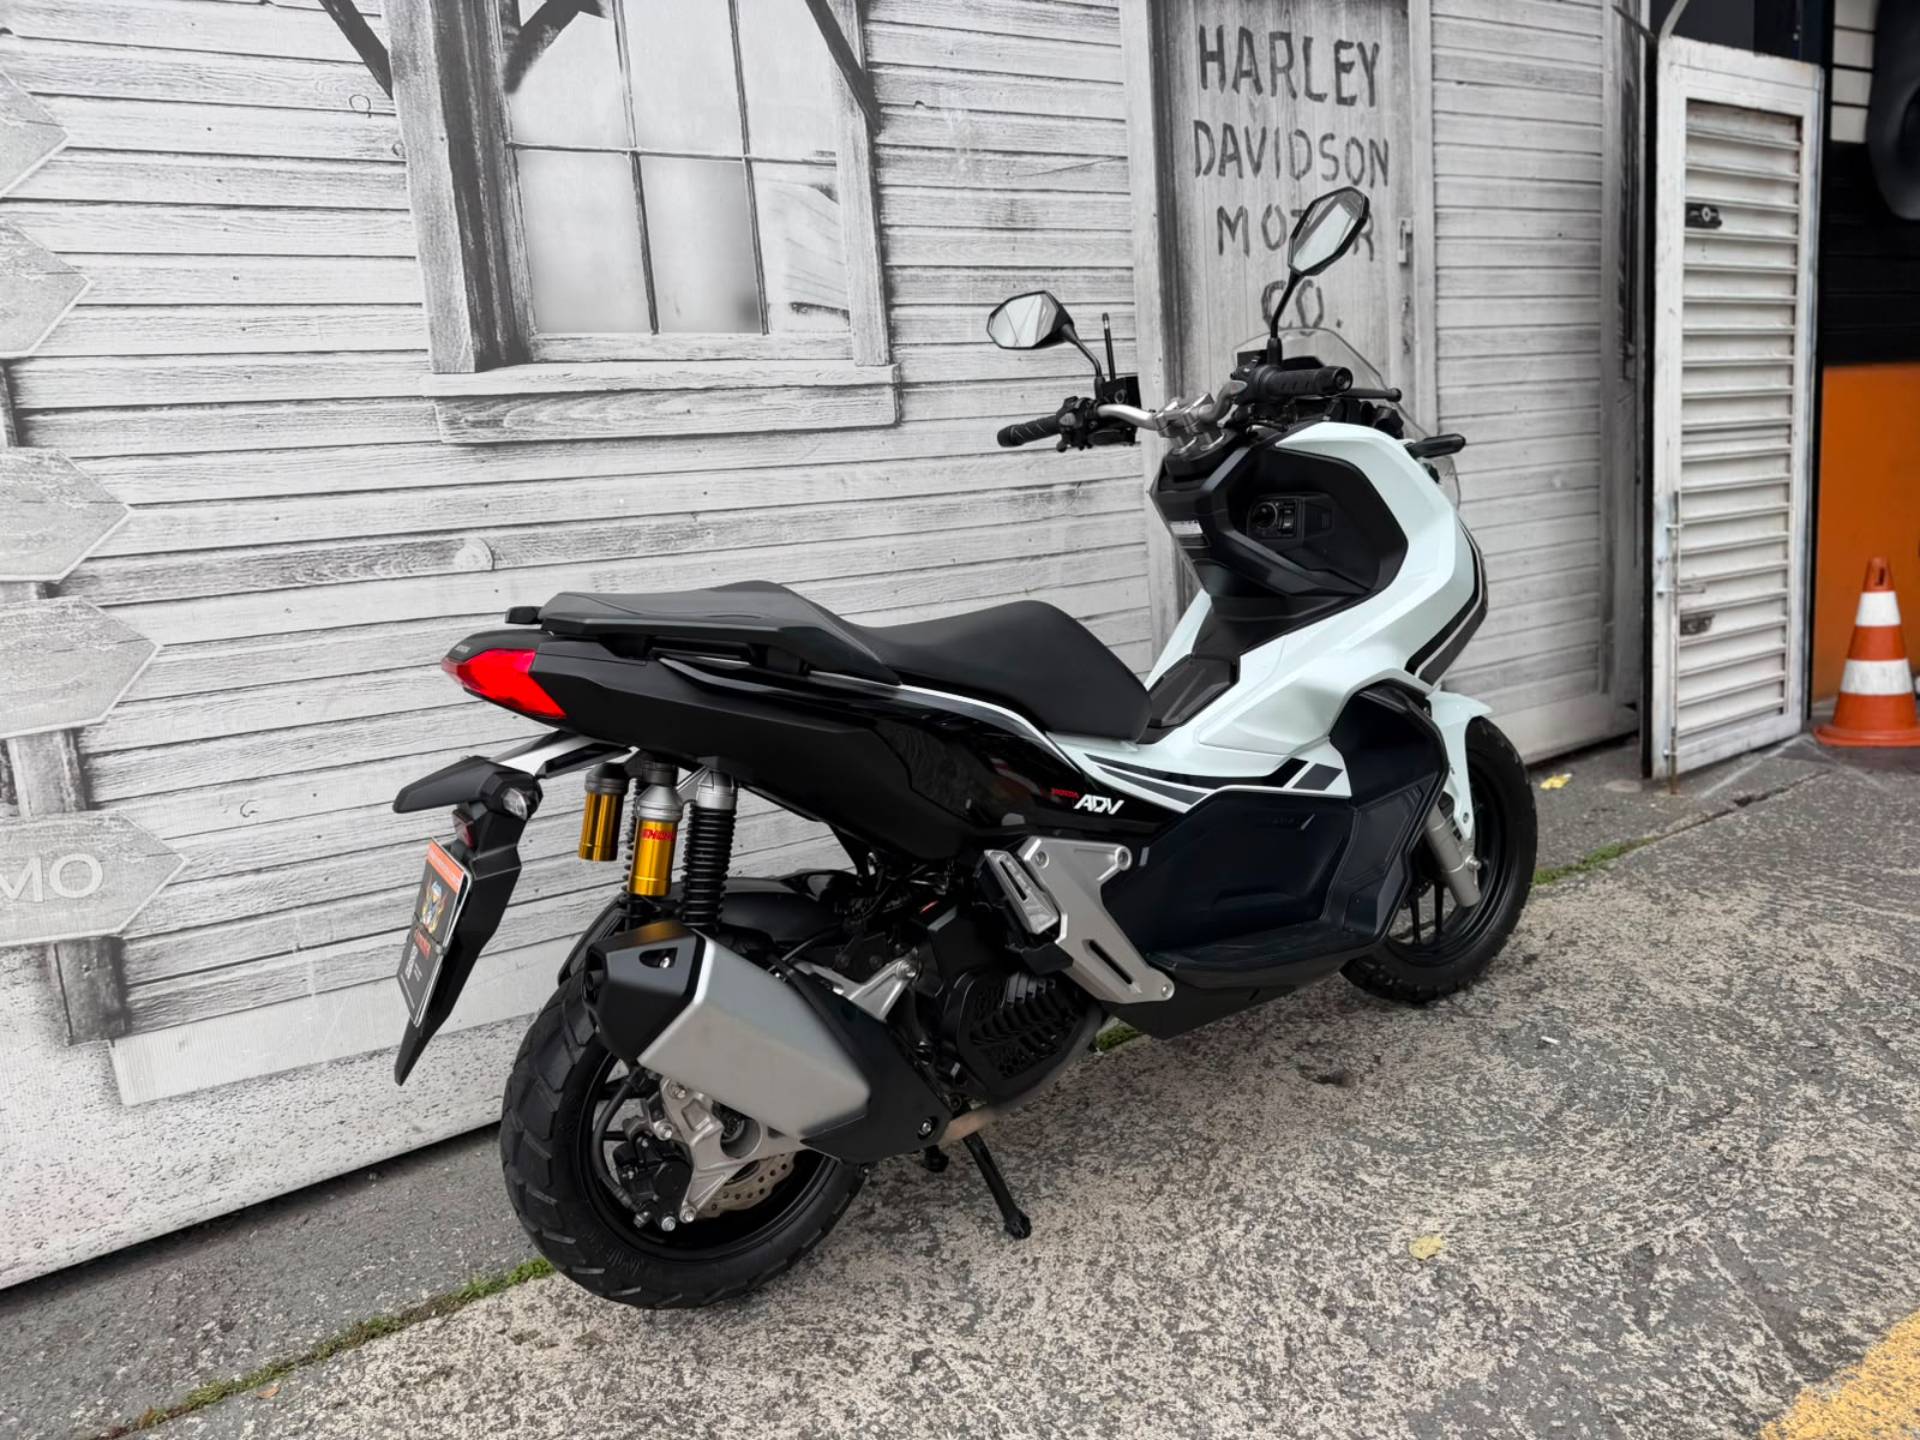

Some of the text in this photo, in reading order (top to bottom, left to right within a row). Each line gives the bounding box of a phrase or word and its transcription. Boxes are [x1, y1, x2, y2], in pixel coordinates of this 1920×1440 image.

[1198, 24, 1380, 108] HARLEY
[1193, 119, 1389, 188] DAVIDSON
[1216, 202, 1375, 262] MOR
[1073, 793, 1125, 815] ADV
